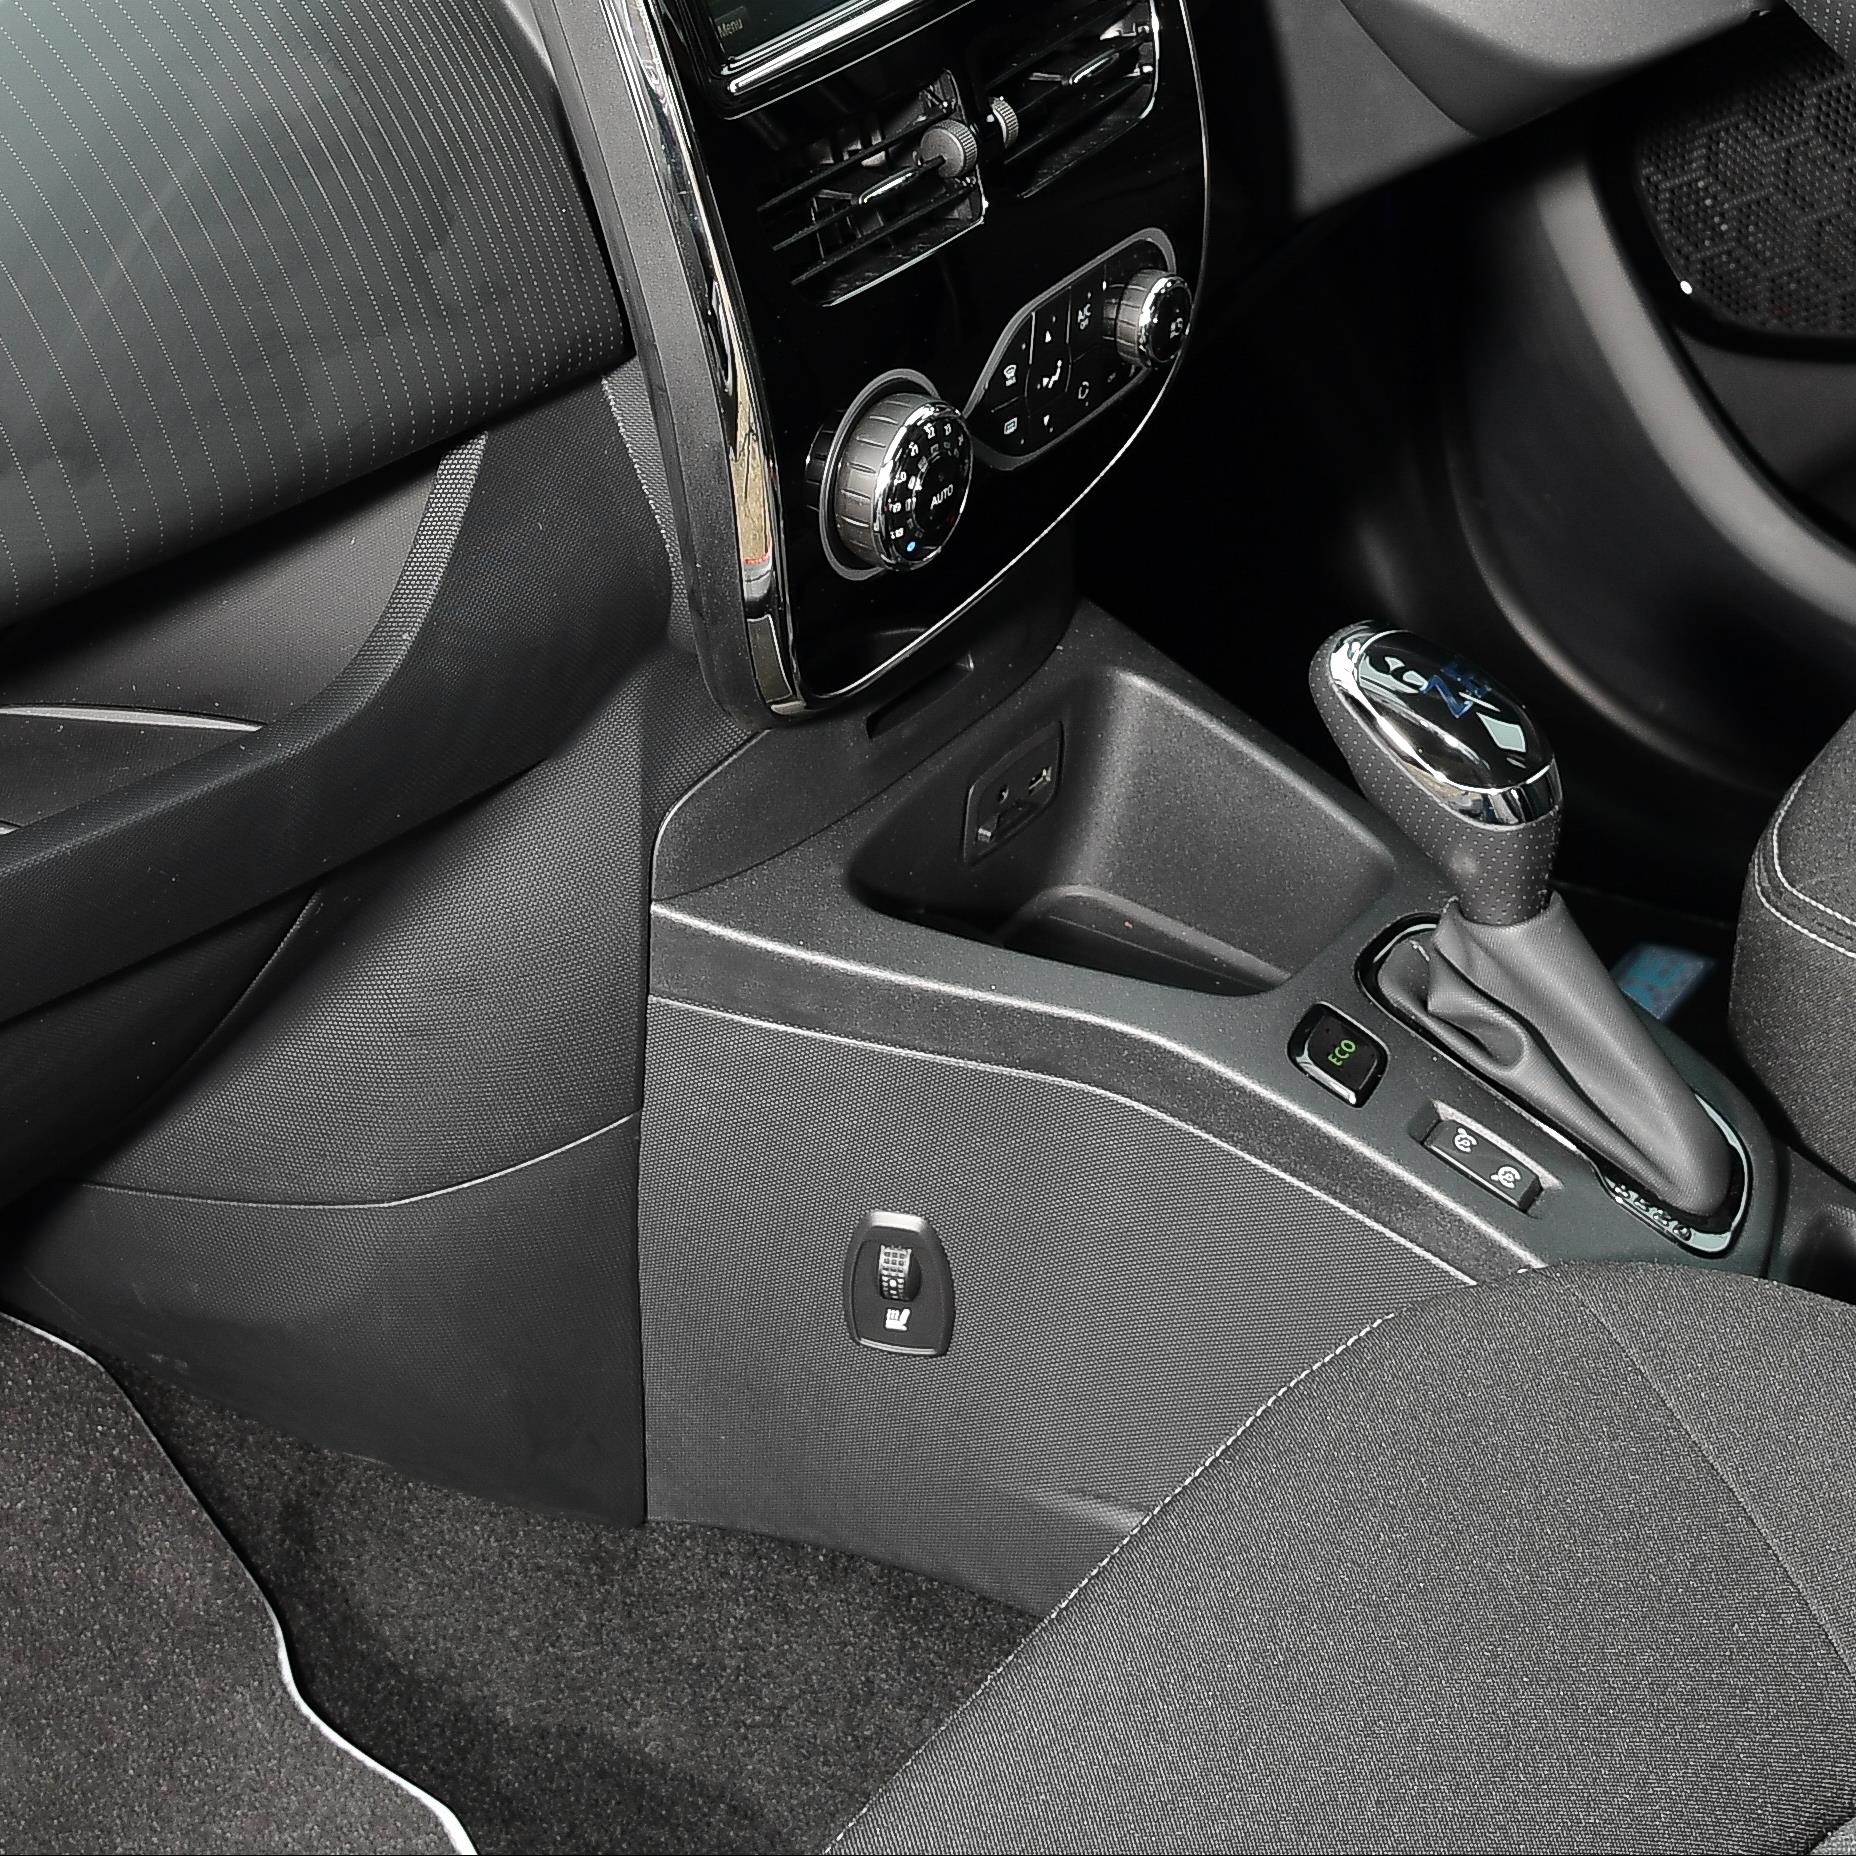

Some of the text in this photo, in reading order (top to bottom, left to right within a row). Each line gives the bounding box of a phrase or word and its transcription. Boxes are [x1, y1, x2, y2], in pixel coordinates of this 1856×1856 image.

[717, 17, 744, 38] Menu
[929, 483, 954, 511] AUTO
[1327, 1039, 1357, 1067] ECO
